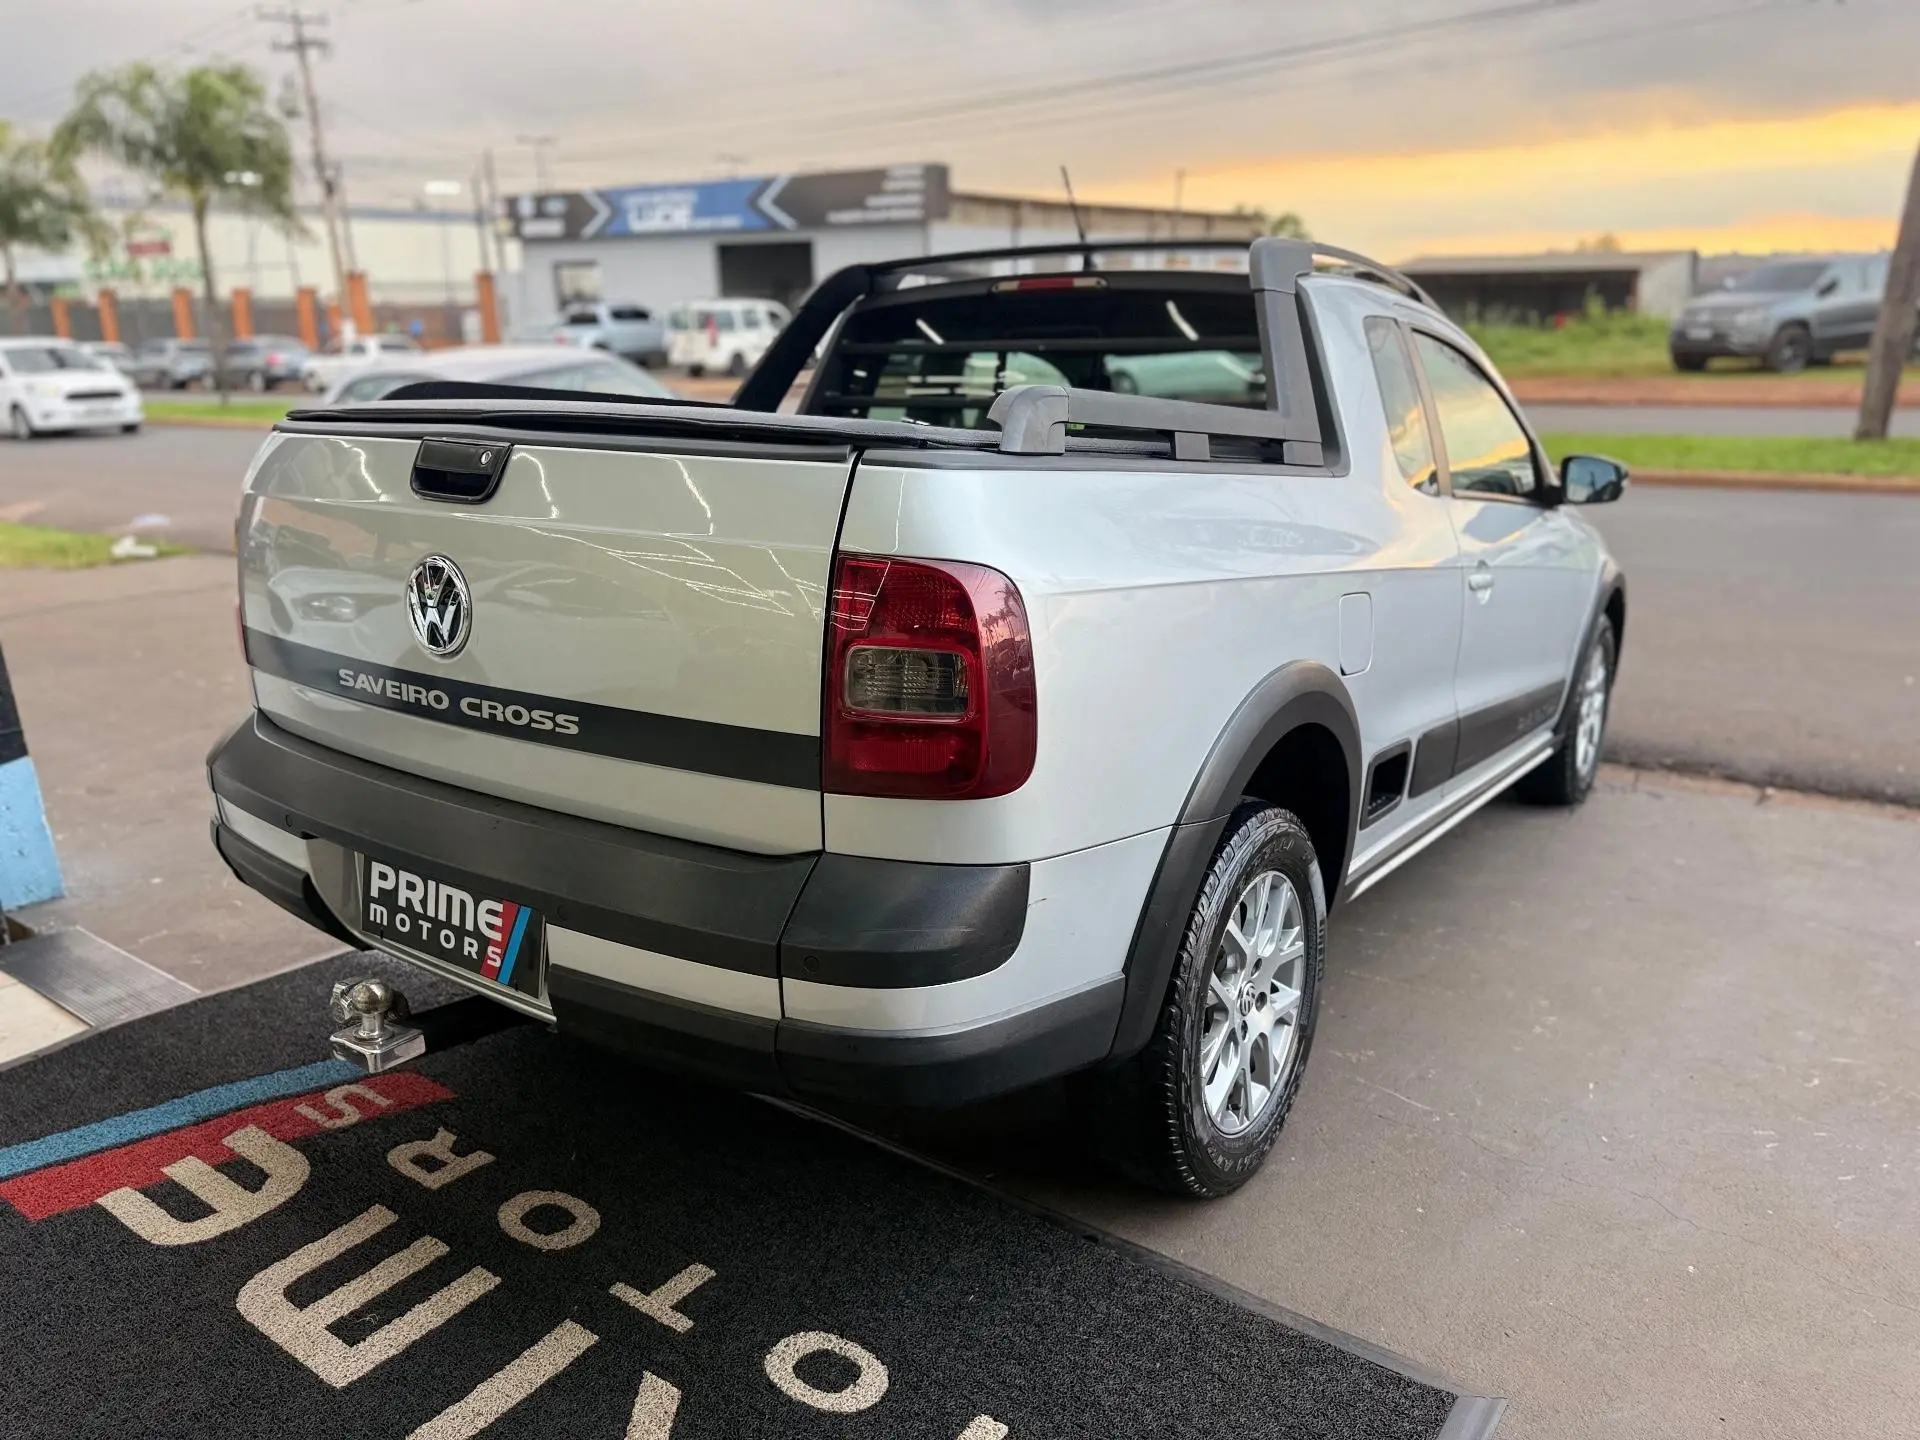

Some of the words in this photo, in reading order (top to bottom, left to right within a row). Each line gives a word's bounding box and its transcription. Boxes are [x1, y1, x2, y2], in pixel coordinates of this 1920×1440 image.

[338, 668, 450, 710] SAVEIRO
[459, 697, 580, 735] CROSS
[369, 903, 502, 968] MOTORS
[370, 861, 504, 942] PRIME
[295, 1083, 1008, 1440] OTORS
